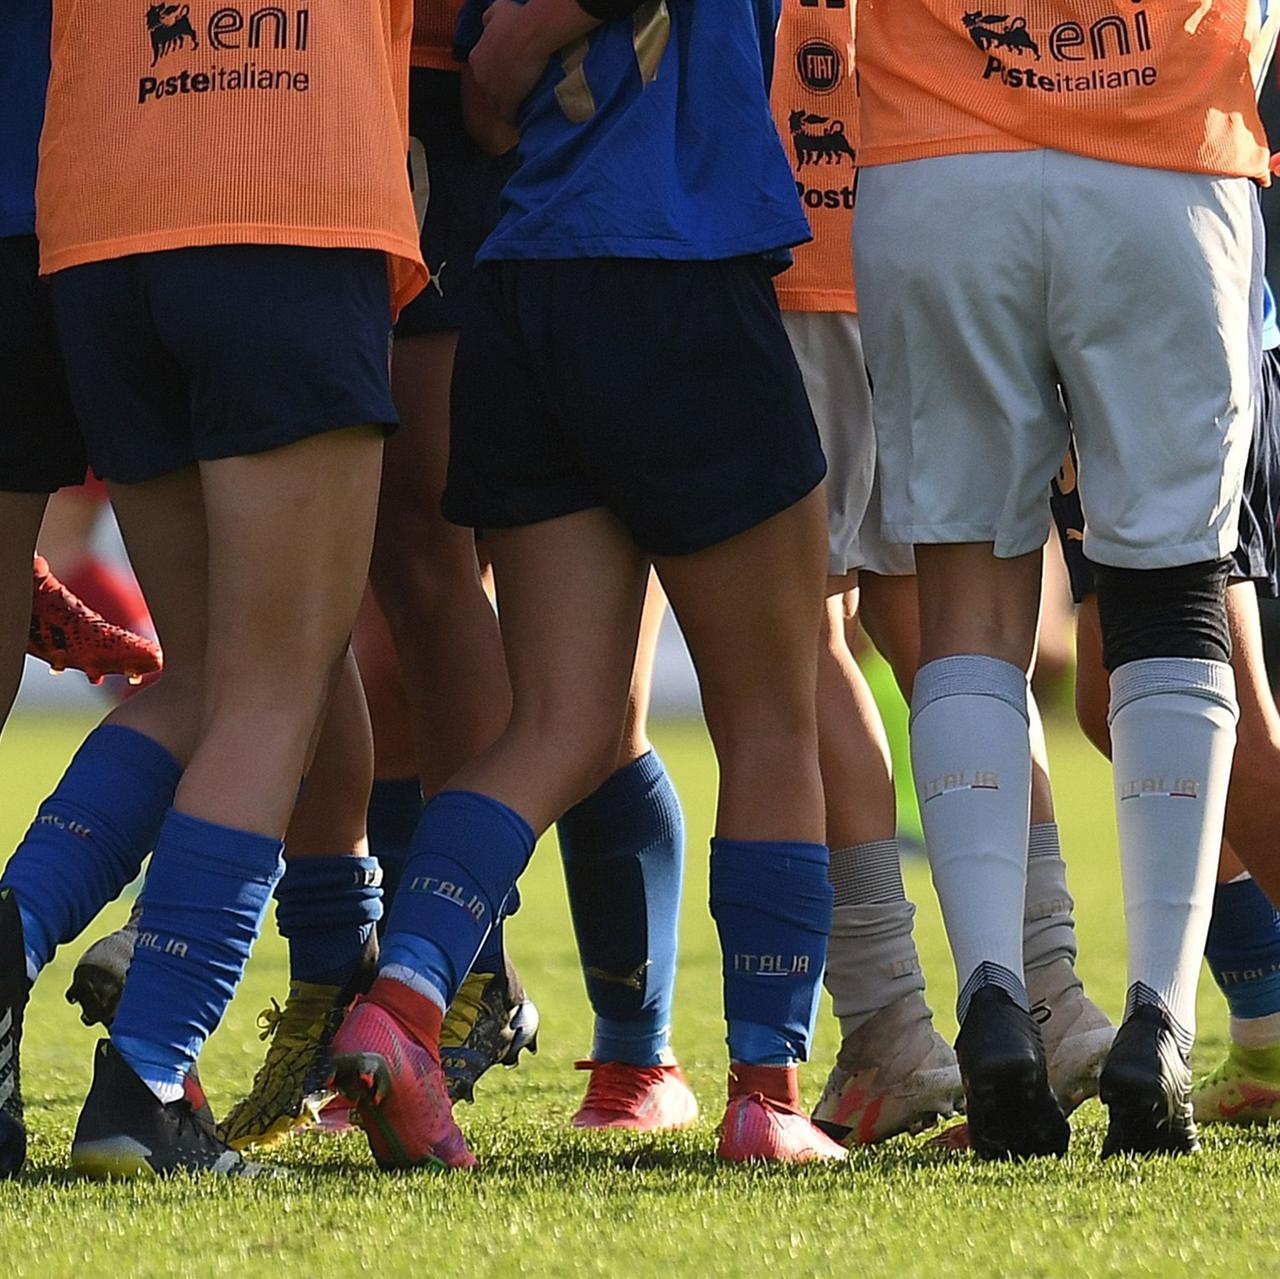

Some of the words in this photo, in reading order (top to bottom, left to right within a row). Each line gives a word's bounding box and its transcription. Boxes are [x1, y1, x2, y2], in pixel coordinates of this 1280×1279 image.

[807, 55, 832, 78] FIAT
[411, 876, 485, 921] ITALIA
[734, 954, 810, 973] ITALIA
